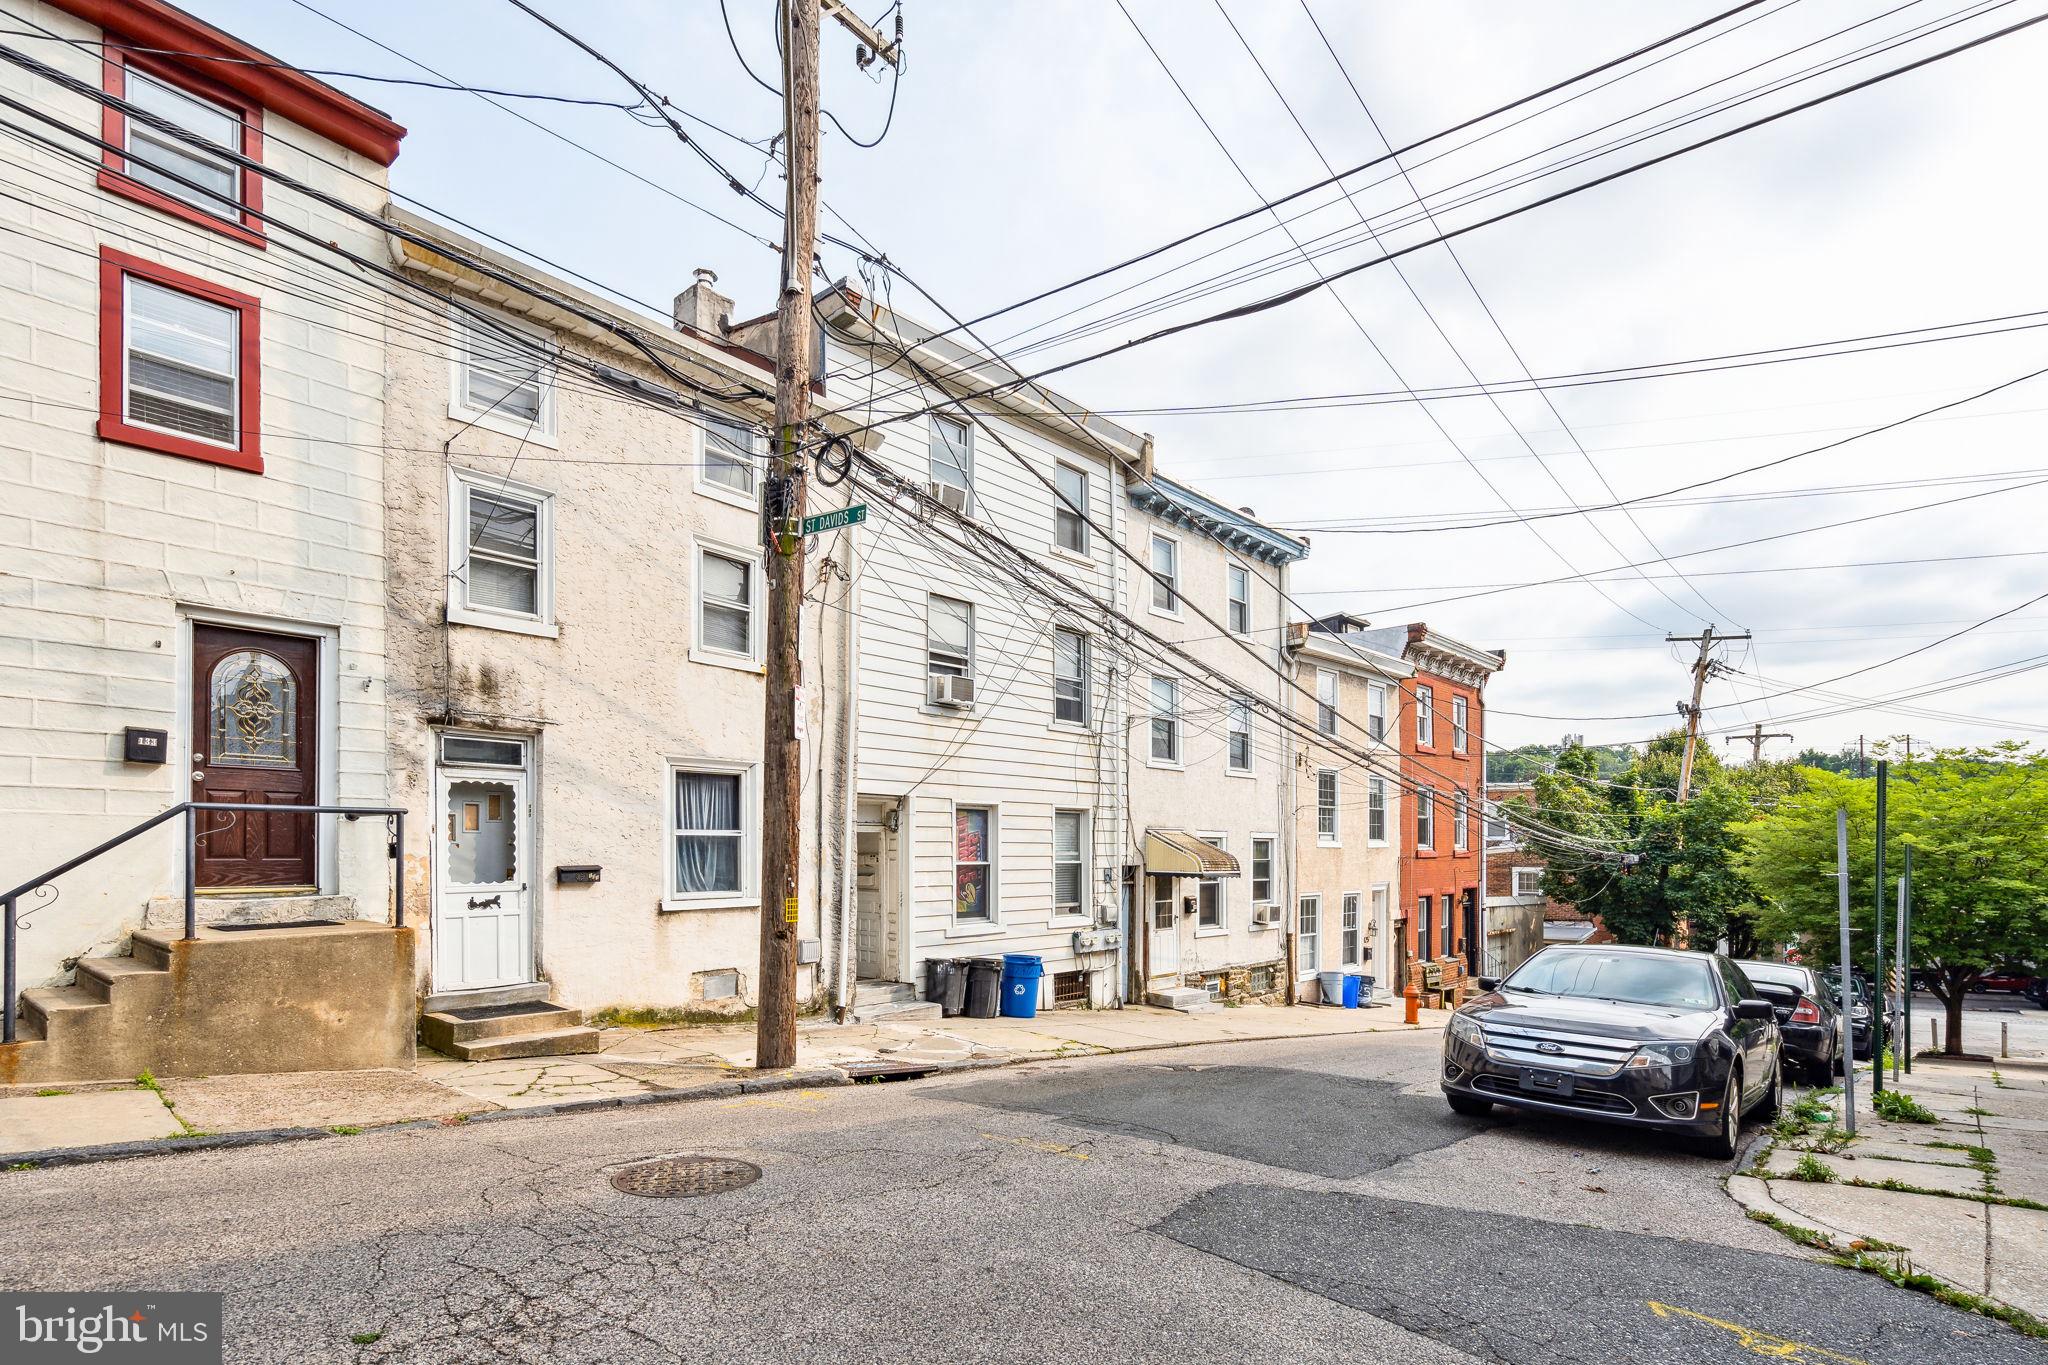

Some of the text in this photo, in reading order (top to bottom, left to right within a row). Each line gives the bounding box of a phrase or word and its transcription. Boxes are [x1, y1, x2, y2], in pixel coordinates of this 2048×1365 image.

[806, 509, 865, 533] ST DAVIDS ST
